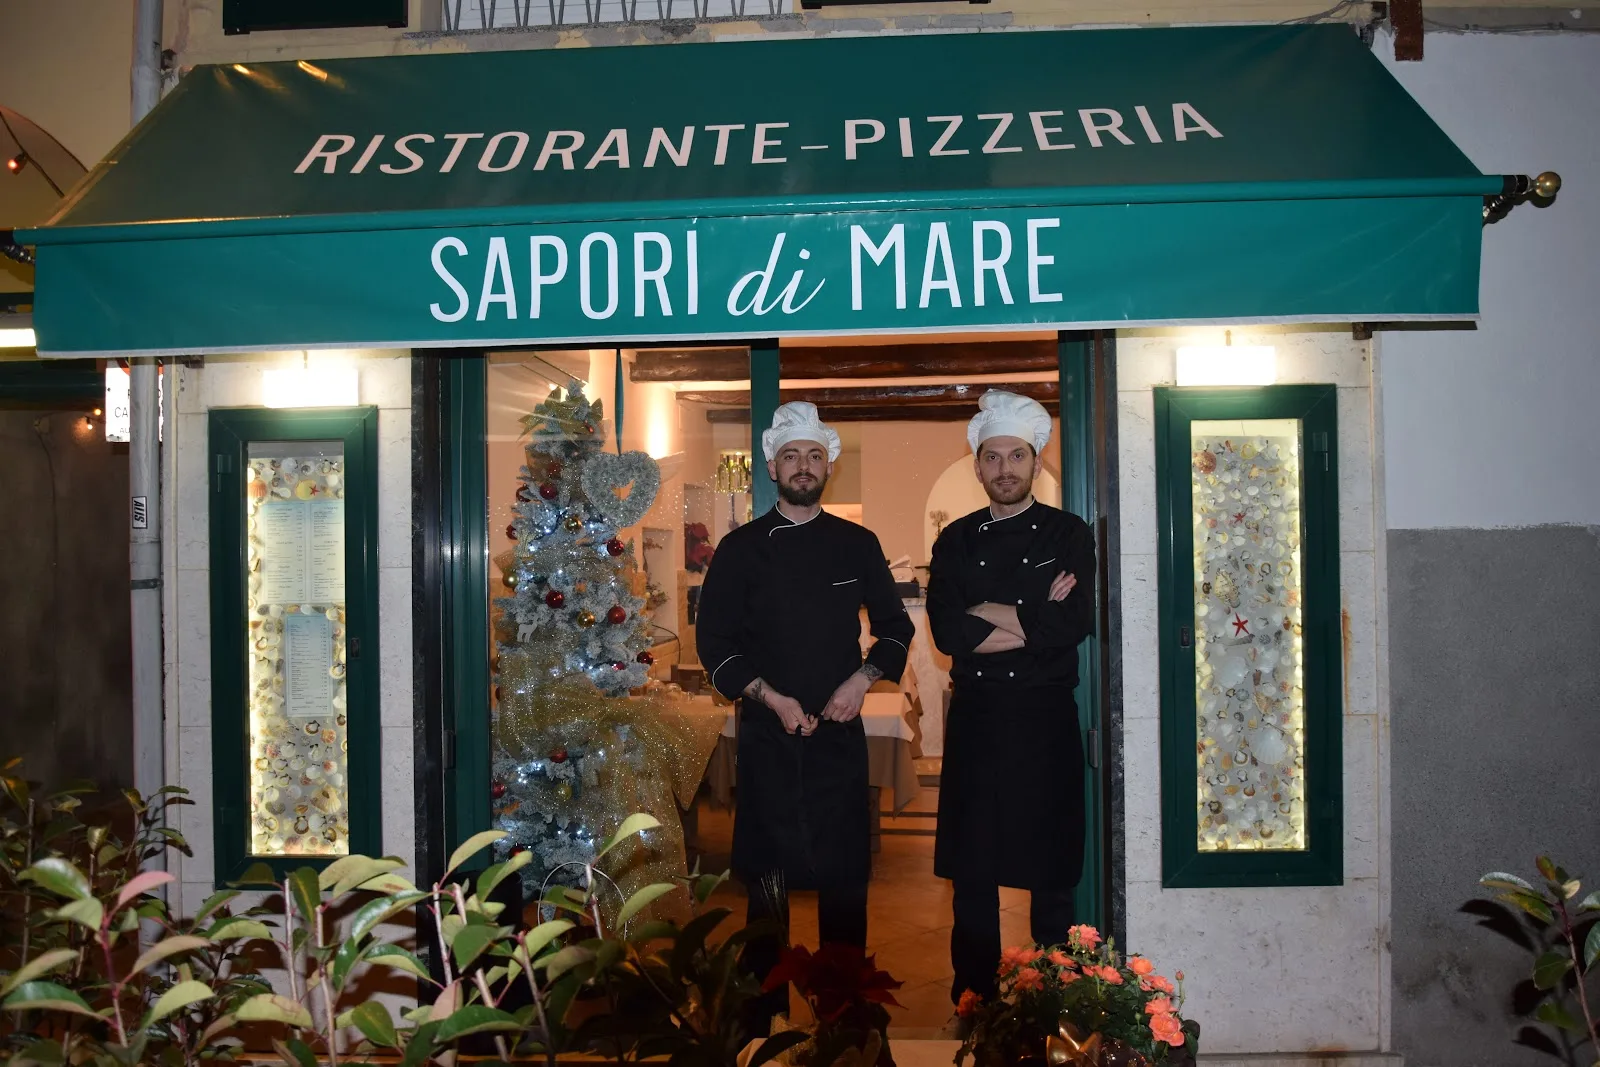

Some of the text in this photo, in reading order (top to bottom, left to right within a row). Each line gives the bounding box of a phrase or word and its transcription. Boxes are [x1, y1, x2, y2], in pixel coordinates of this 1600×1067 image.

[430, 218, 1063, 323] SAPORI di MARE
